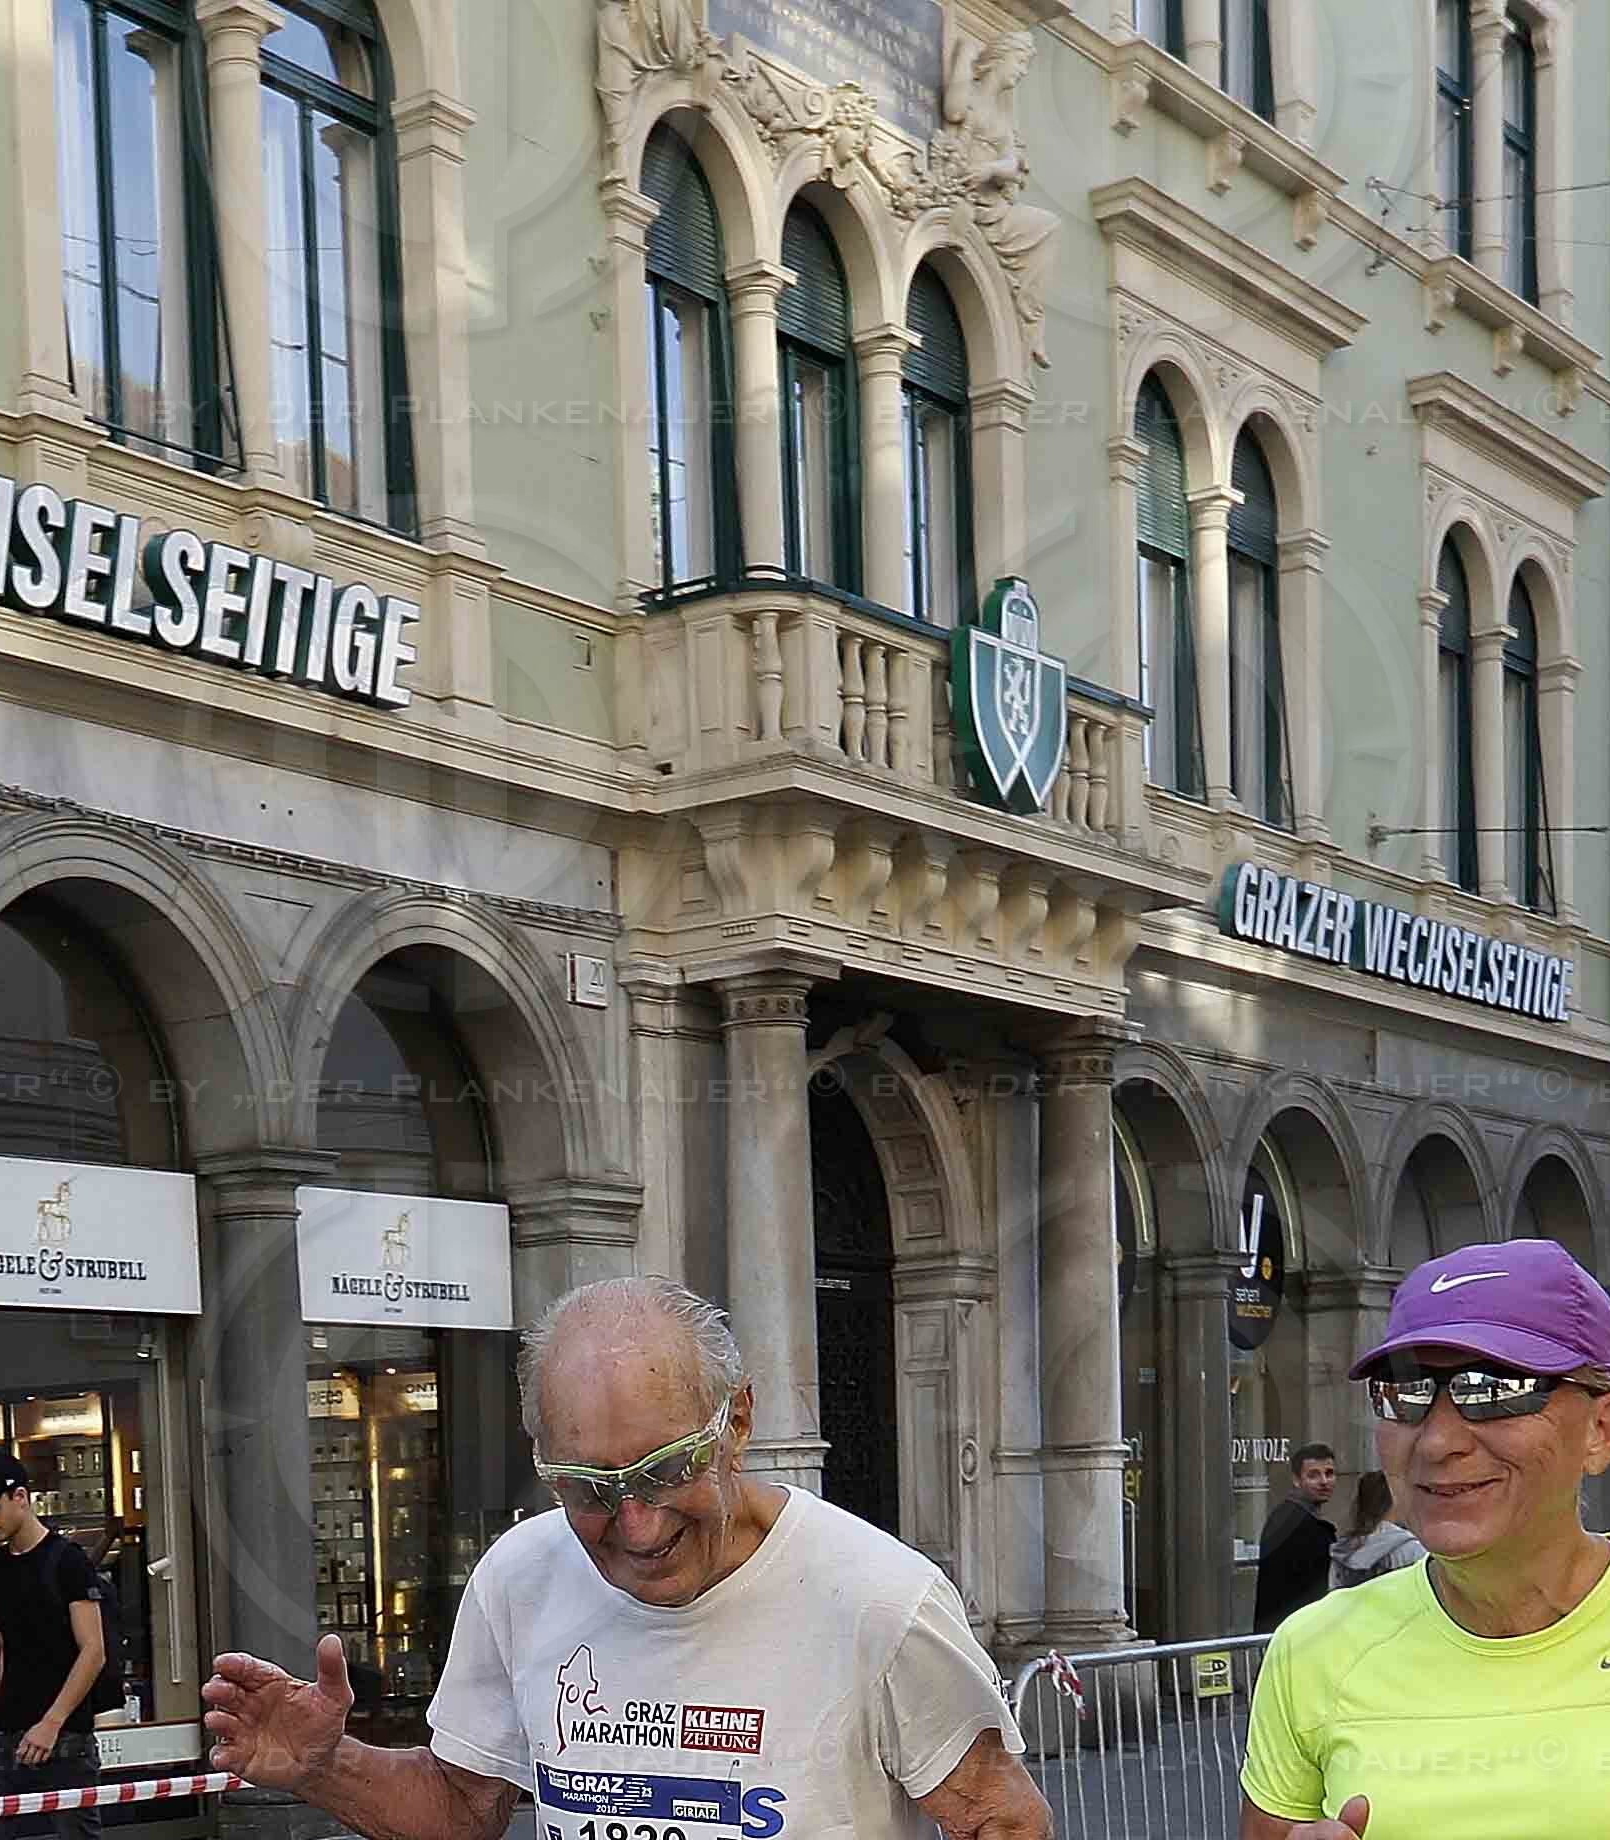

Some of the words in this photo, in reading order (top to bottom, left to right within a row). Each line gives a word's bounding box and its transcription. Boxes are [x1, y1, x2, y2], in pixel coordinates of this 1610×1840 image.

[1227, 861, 1355, 963] GRAZER
[1359, 901, 1574, 1021] WECHSELSEITIGE
[38, 1248, 64, 1281] &
[65, 1258, 147, 1281] STRUBELL
[332, 1273, 382, 1294] NÄGELE
[383, 1272, 404, 1301] &
[405, 1282, 470, 1302] STRUBELL
[624, 1701, 677, 1725] GRAZ
[684, 1709, 760, 1732] KLEINE
[570, 1720, 675, 1749] MARATHON
[683, 1731, 758, 1750] ZEITUNG
[571, 1774, 625, 1794] GRAZ
[561, 1791, 609, 1804] MARATHON
[595, 1804, 618, 1814] 2018
